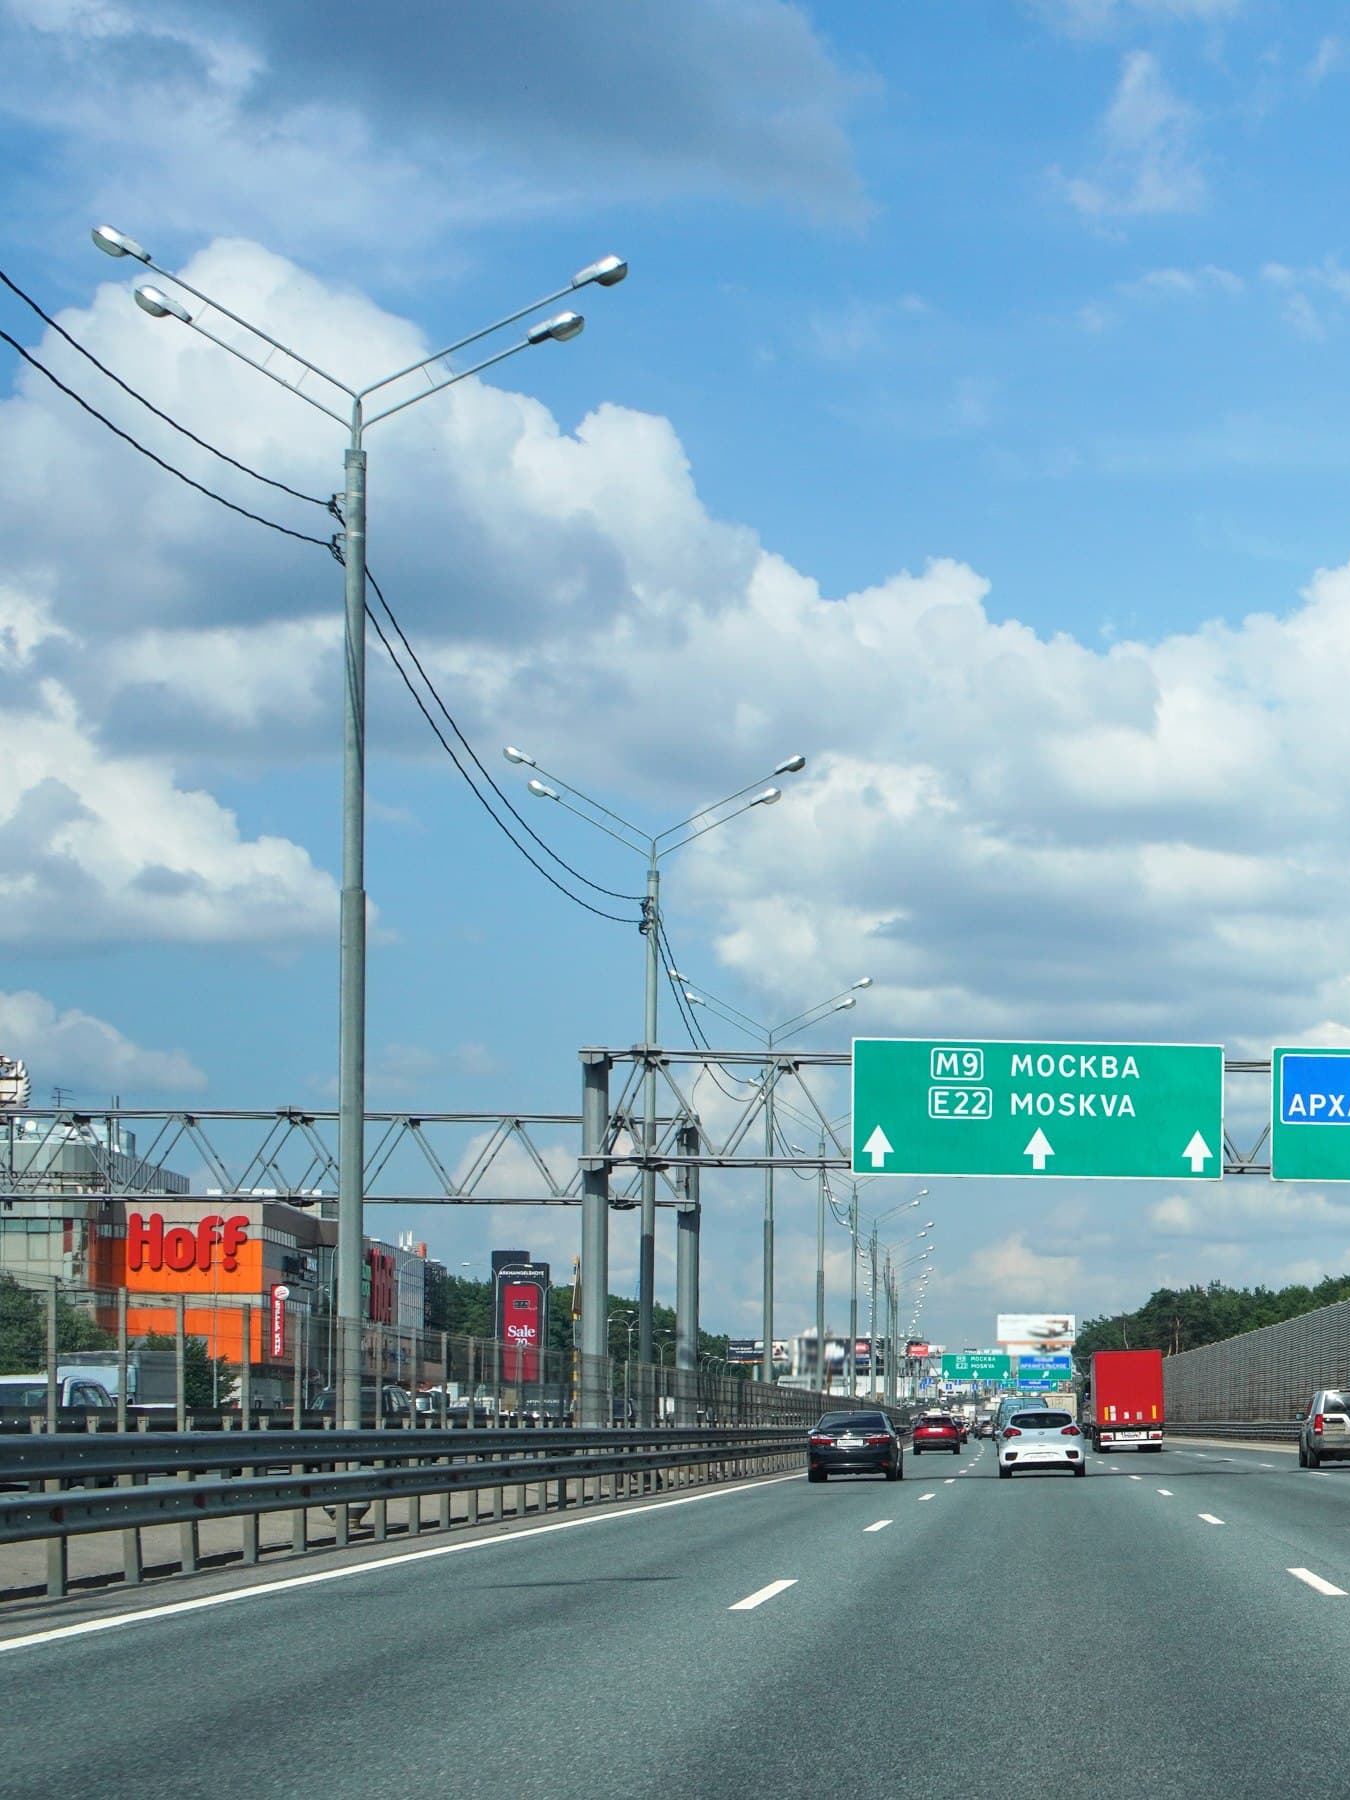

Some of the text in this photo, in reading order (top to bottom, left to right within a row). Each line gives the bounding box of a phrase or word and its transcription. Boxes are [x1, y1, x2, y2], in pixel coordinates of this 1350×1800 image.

[1011, 1054, 1140, 1079] МОСКВА
[934, 1092, 987, 1115] E22
[1010, 1092, 1136, 1117] MOSKVA
[507, 1325, 536, 1338] Sale
